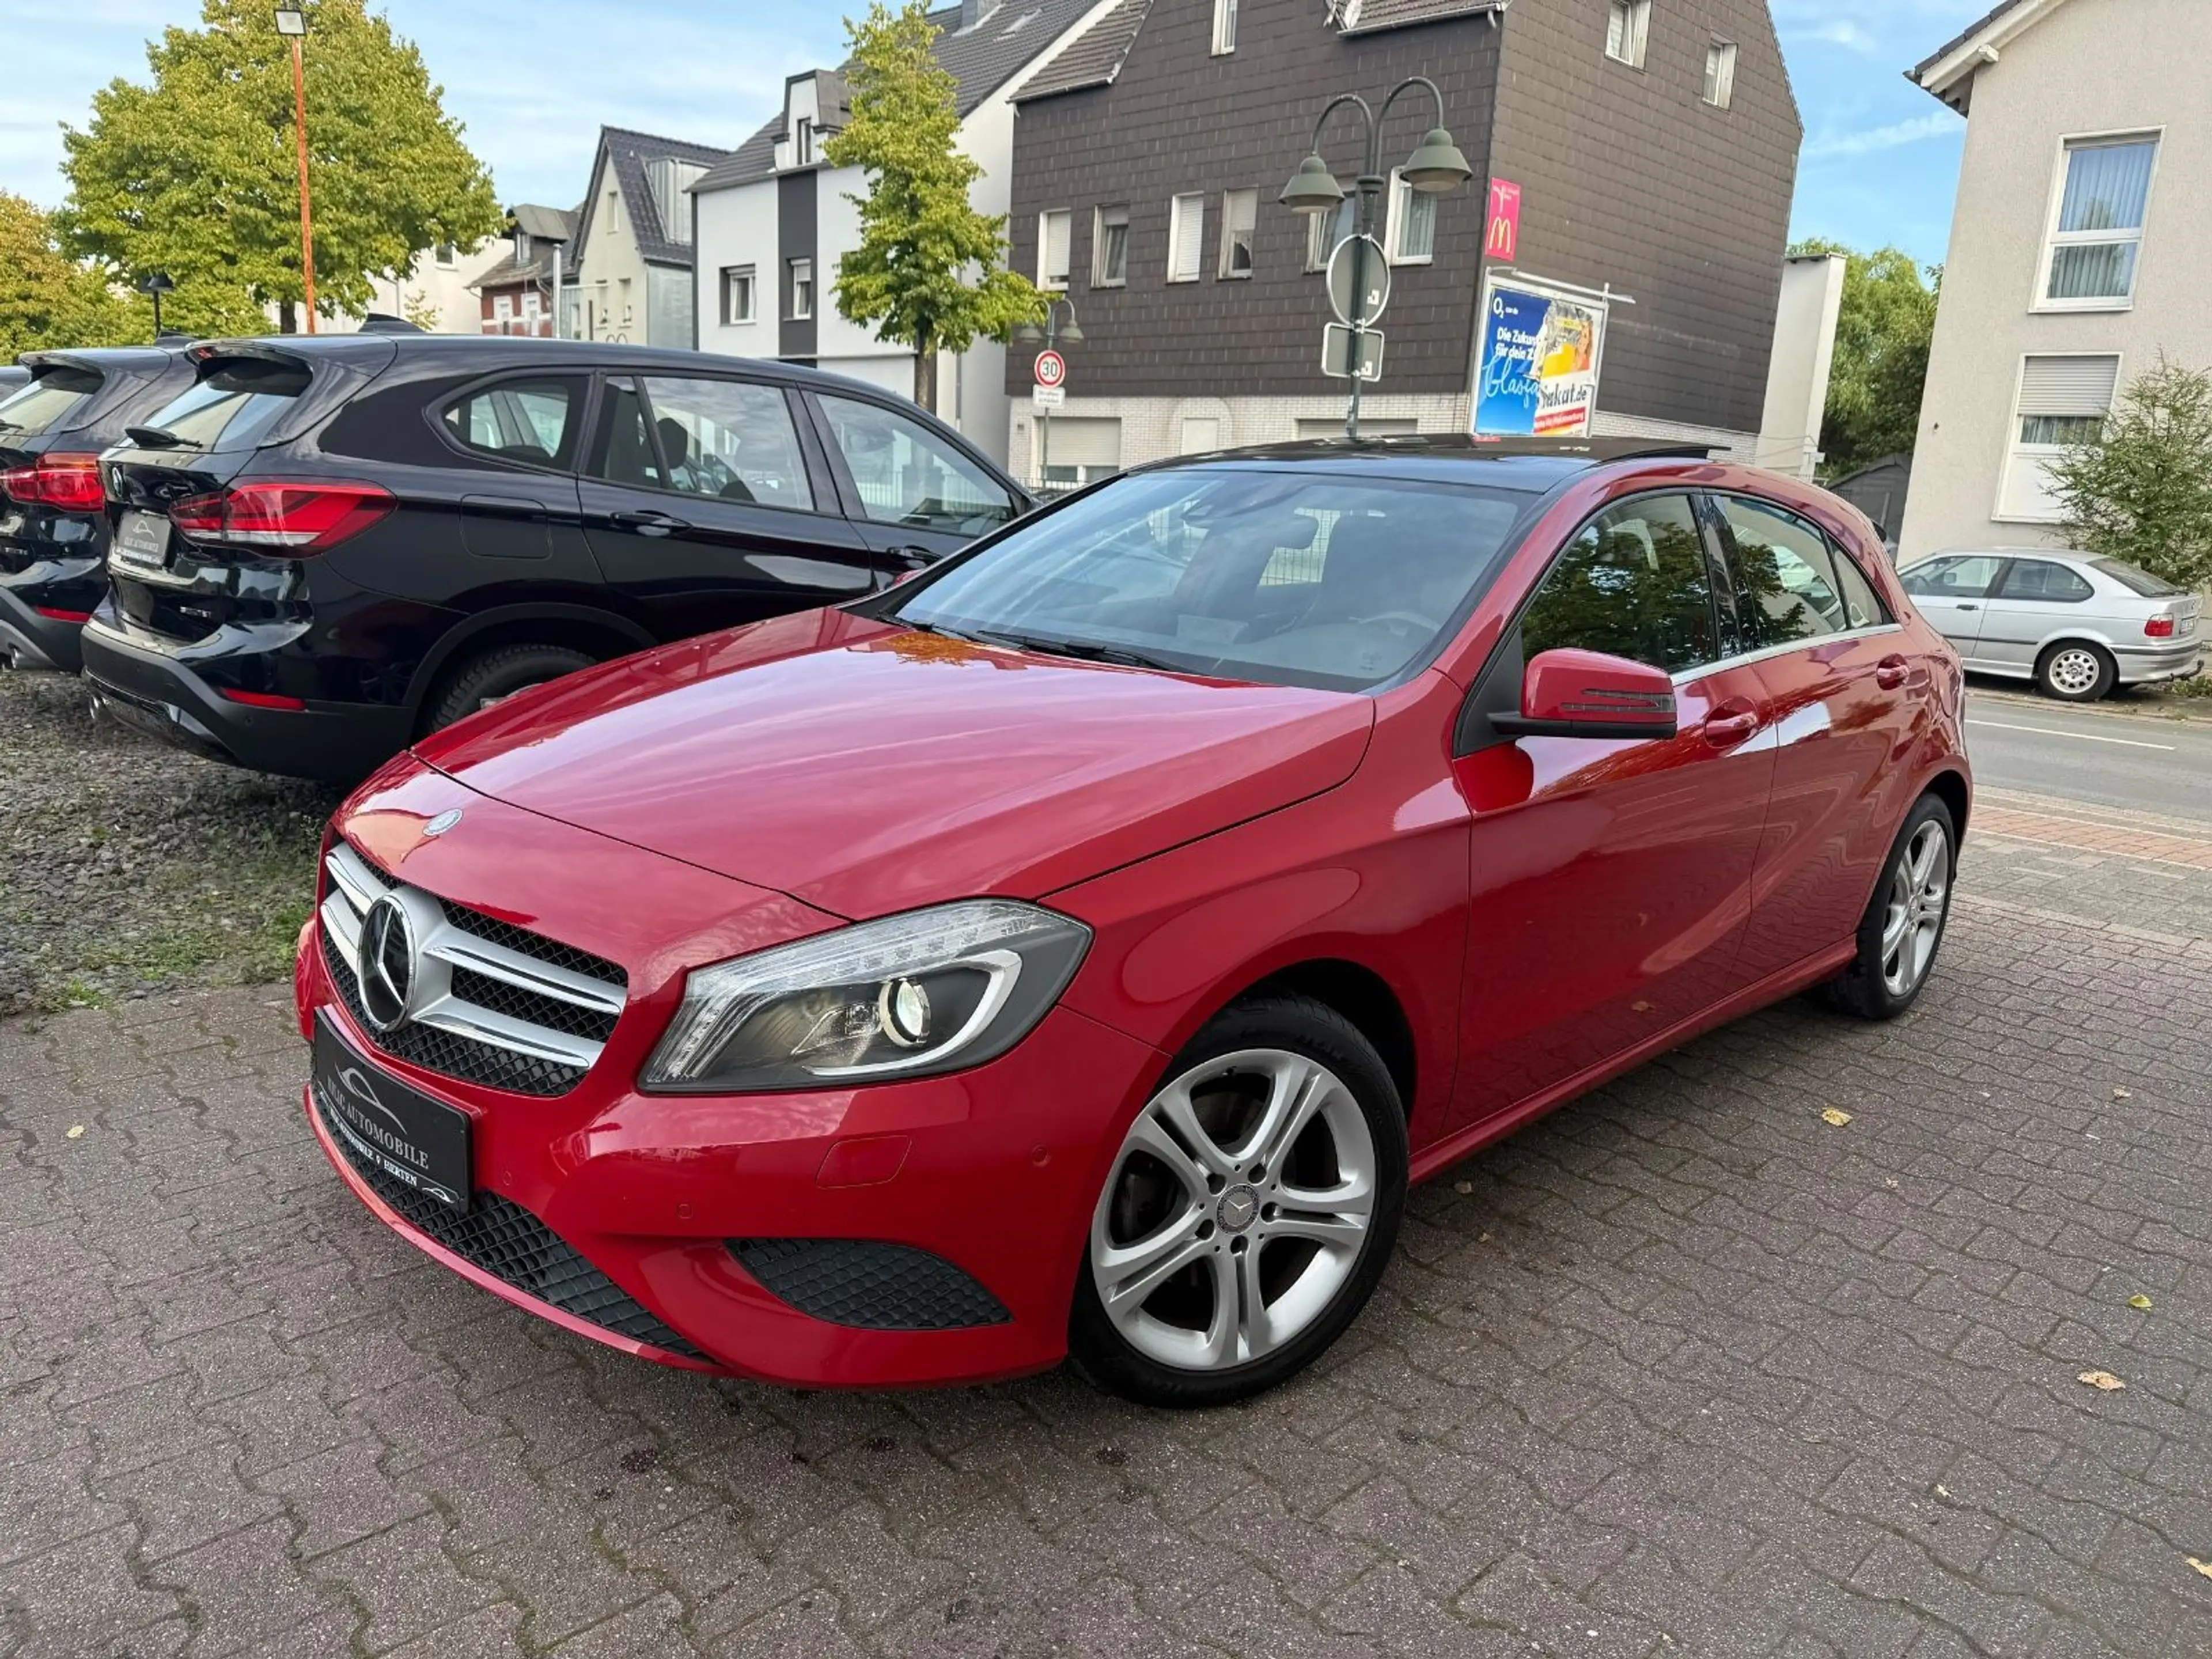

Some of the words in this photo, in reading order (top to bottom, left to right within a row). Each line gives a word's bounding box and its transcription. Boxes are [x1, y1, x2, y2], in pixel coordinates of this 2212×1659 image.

[1497, 326, 1512, 342] Die
[1512, 329, 1536, 347] Zukun
[1495, 342, 1509, 357] für
[1509, 344, 1526, 360] dein
[1042, 360, 1058, 377] 30
[1482, 353, 1540, 408] Glasfa
[347, 1103, 429, 1169] AUTOMOBILE
